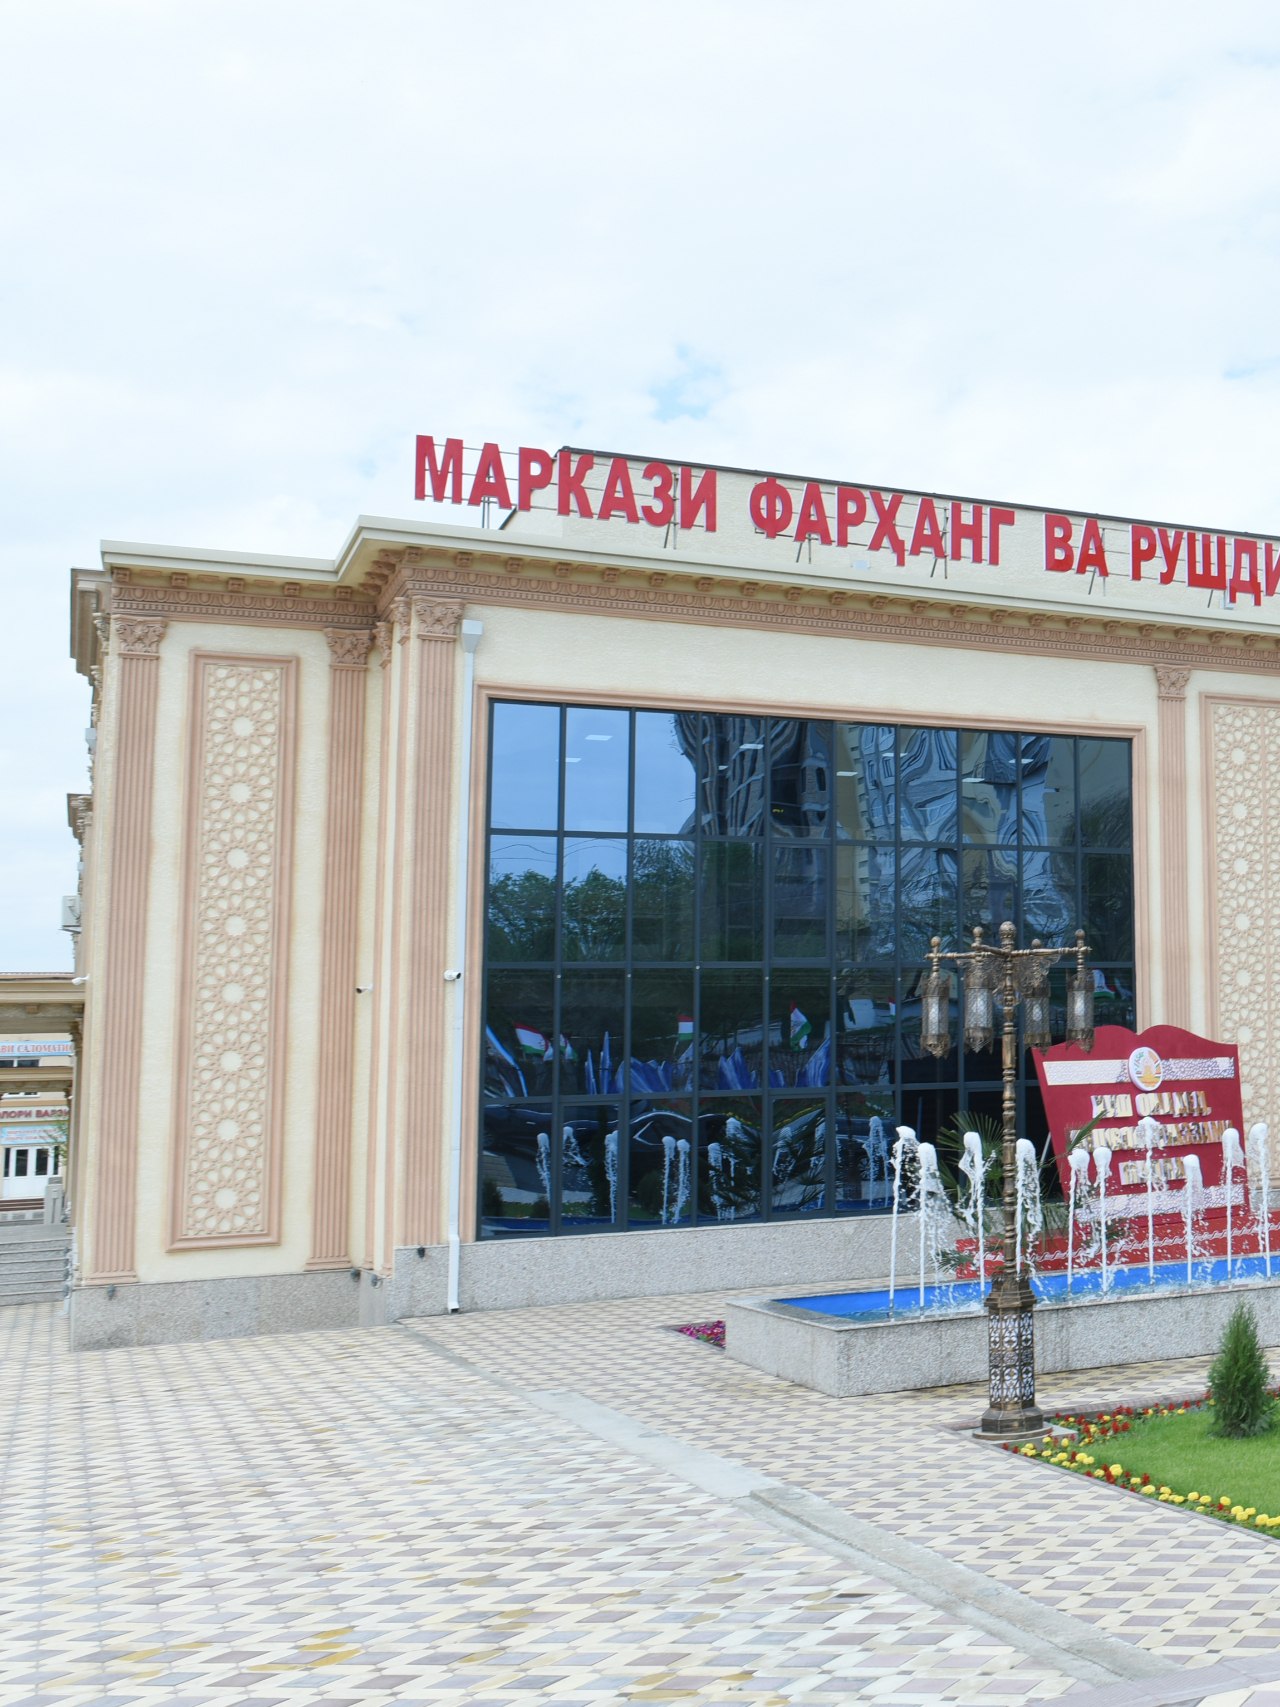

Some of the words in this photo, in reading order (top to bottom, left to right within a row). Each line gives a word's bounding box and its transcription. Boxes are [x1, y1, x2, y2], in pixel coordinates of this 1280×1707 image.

[414, 434, 717, 533] МАРКАЗИ
[749, 477, 1015, 567] ФАРҲАНГ
[1043, 513, 1109, 577] ВА
